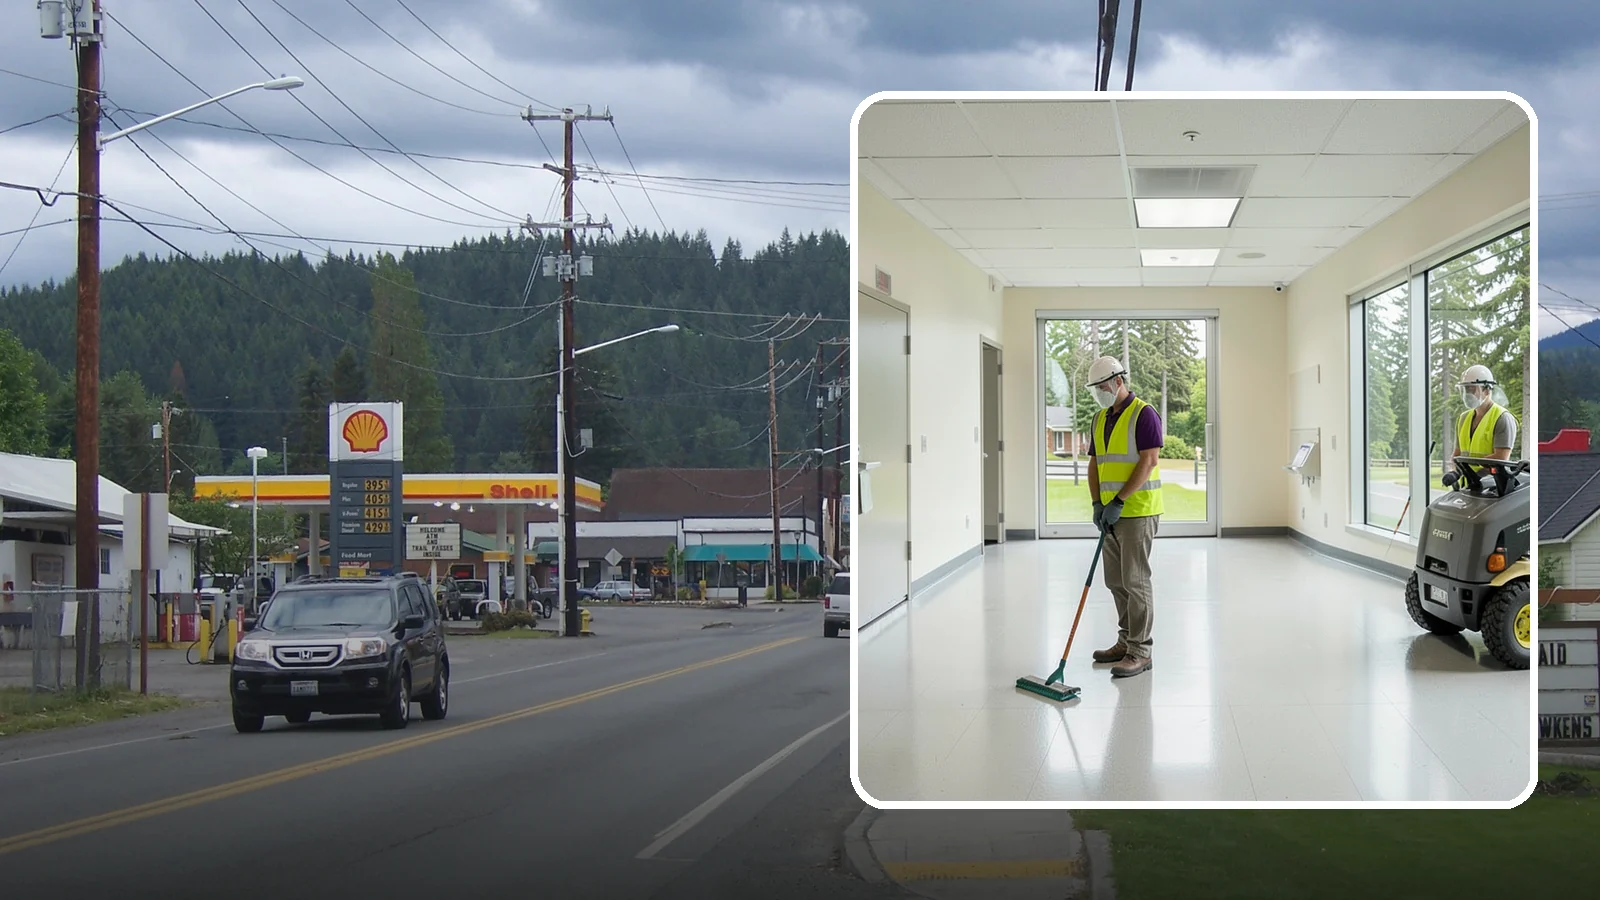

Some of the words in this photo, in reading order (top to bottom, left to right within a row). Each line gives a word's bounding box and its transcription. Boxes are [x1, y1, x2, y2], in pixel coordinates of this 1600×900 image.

[365, 480, 383, 490] 395
[490, 484, 547, 499] Shell
[365, 494, 383, 504] 405
[365, 508, 383, 518] 415
[365, 522, 383, 532] 429
